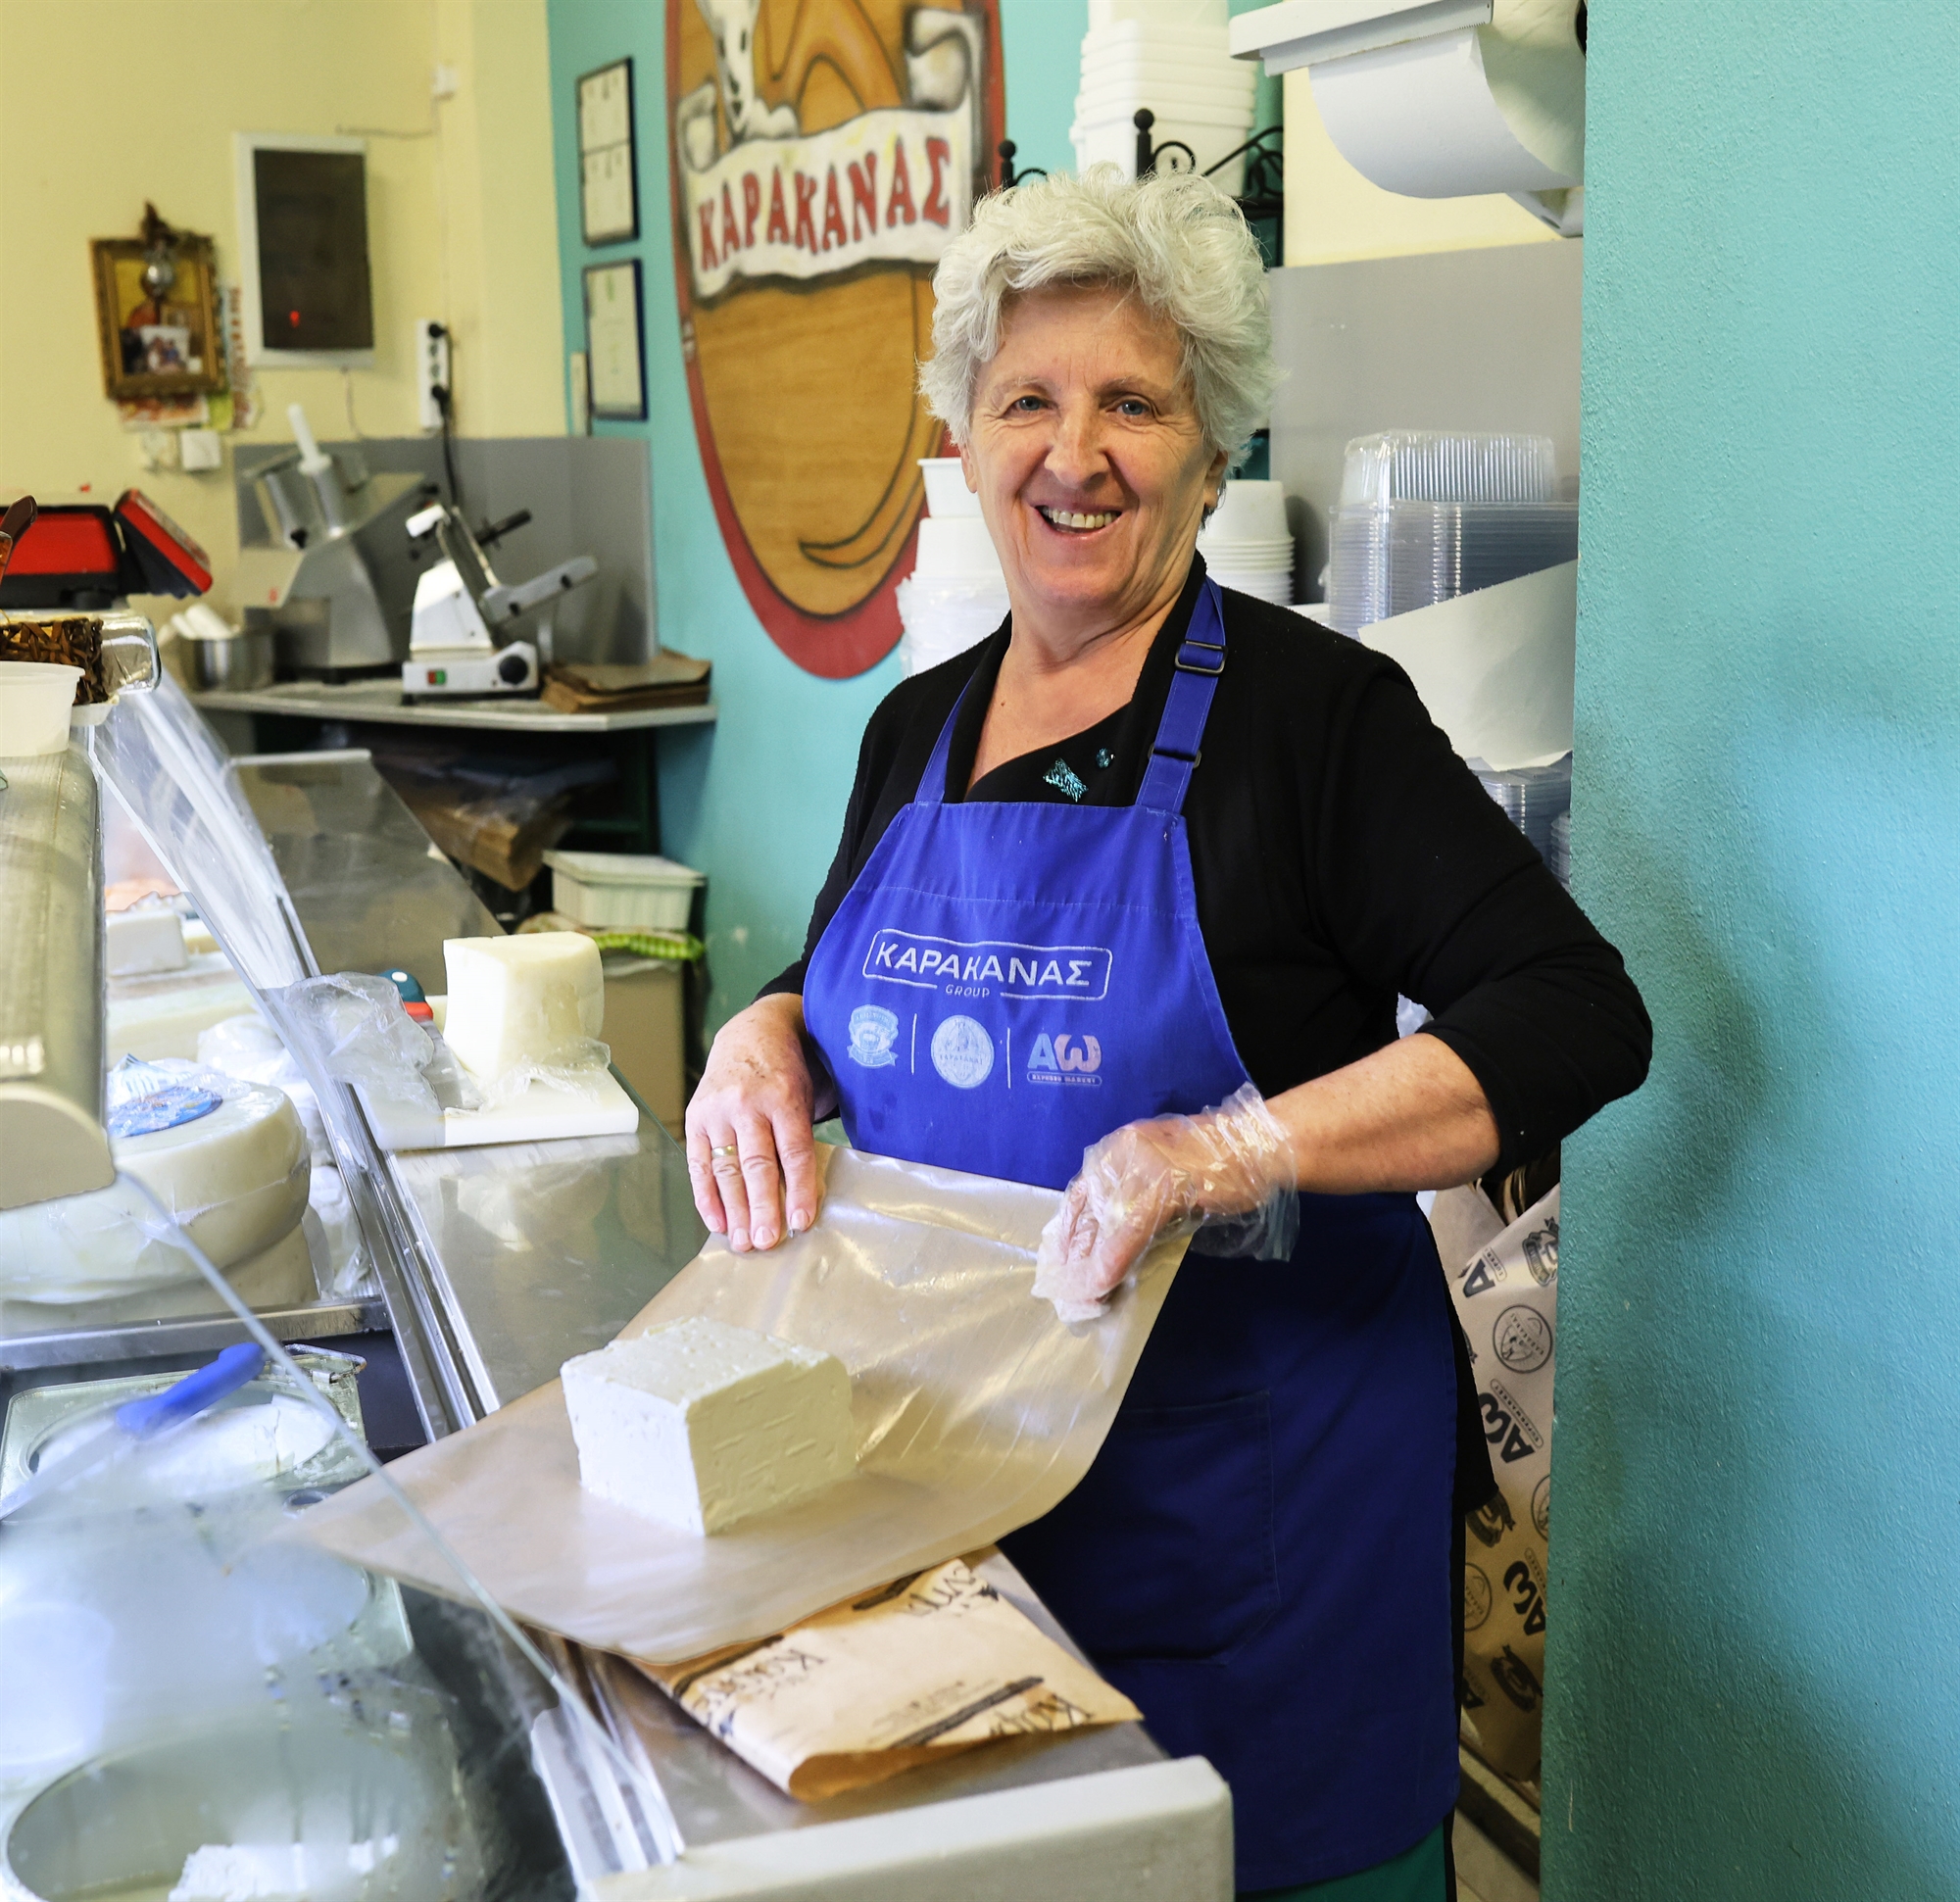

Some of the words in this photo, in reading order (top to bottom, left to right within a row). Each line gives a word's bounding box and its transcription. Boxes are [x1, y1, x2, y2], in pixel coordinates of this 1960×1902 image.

[699, 136, 950, 272] ΚΑΡΑΚΑΝΑΣ
[875, 942, 1093, 988] ΚΑΡΑΚΑΝΑΣ
[945, 983, 991, 999] GROUP
[1494, 1384, 1541, 1444] SUPERMARKET
